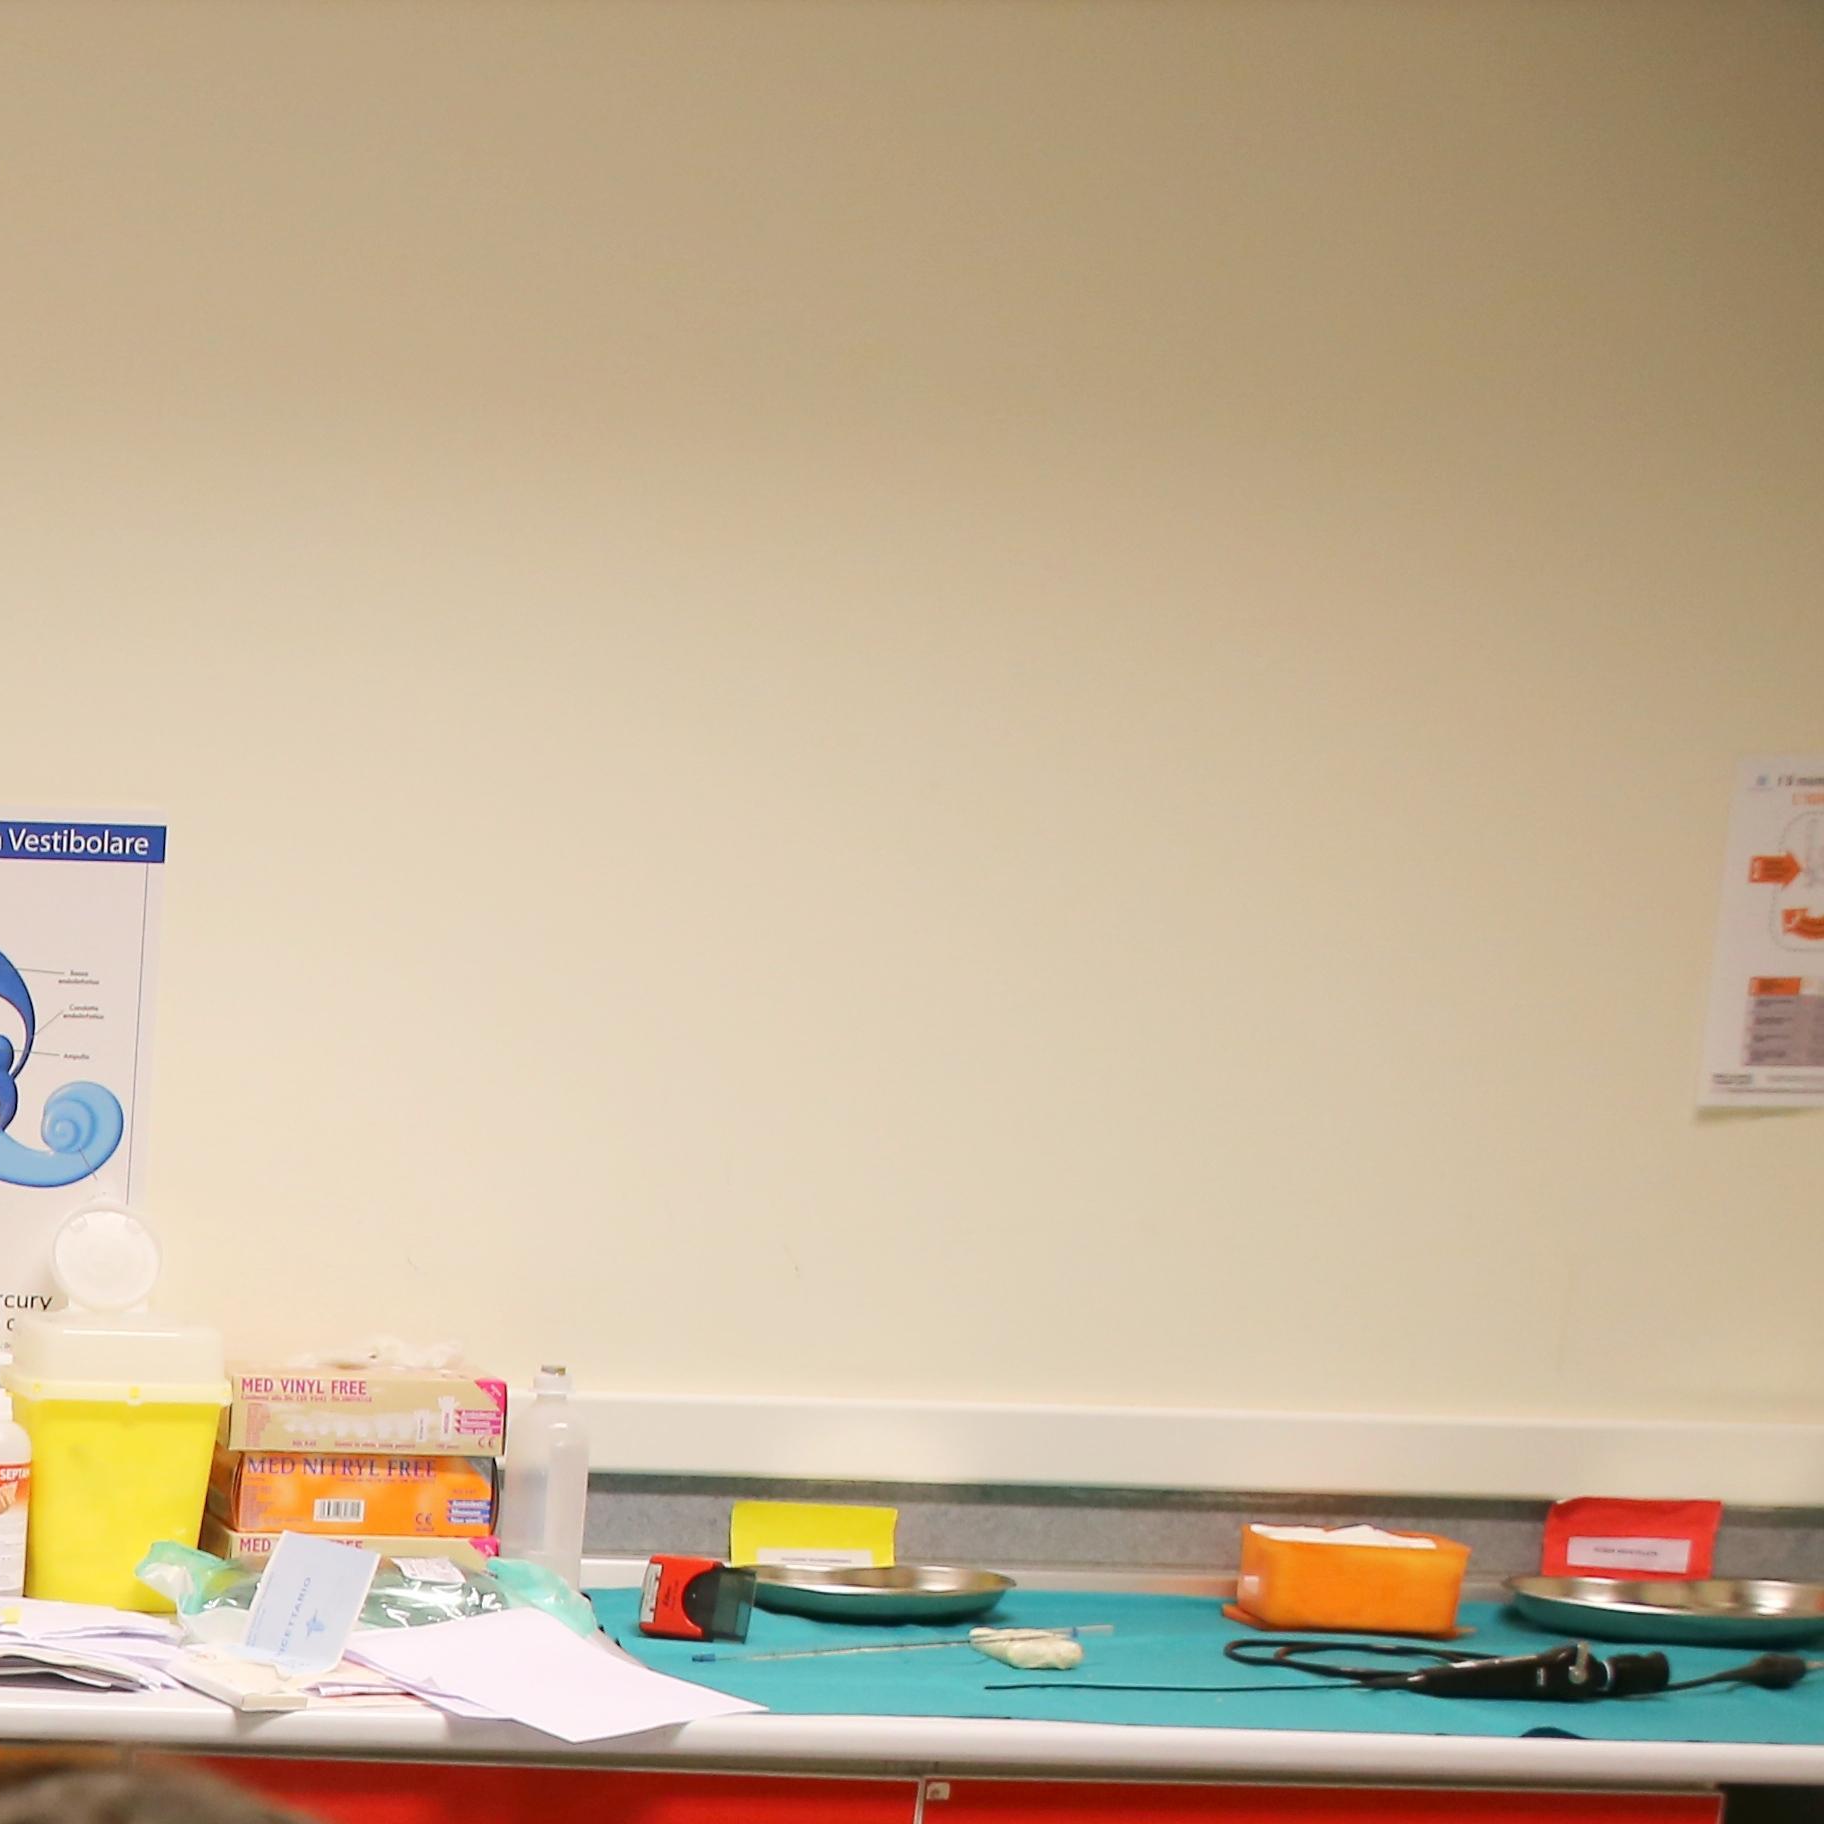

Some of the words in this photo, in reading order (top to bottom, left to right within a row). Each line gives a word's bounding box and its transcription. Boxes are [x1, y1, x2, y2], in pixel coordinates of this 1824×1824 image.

[8, 828, 150, 856] Vestibolare
[241, 1378, 274, 1394] MED
[280, 1379, 325, 1395] VINYL
[331, 1379, 368, 1396] FREE
[246, 1457, 295, 1474] MED
[303, 1458, 380, 1477] NITRYL
[388, 1459, 437, 1478] FREE
[240, 1538, 271, 1552] MED
